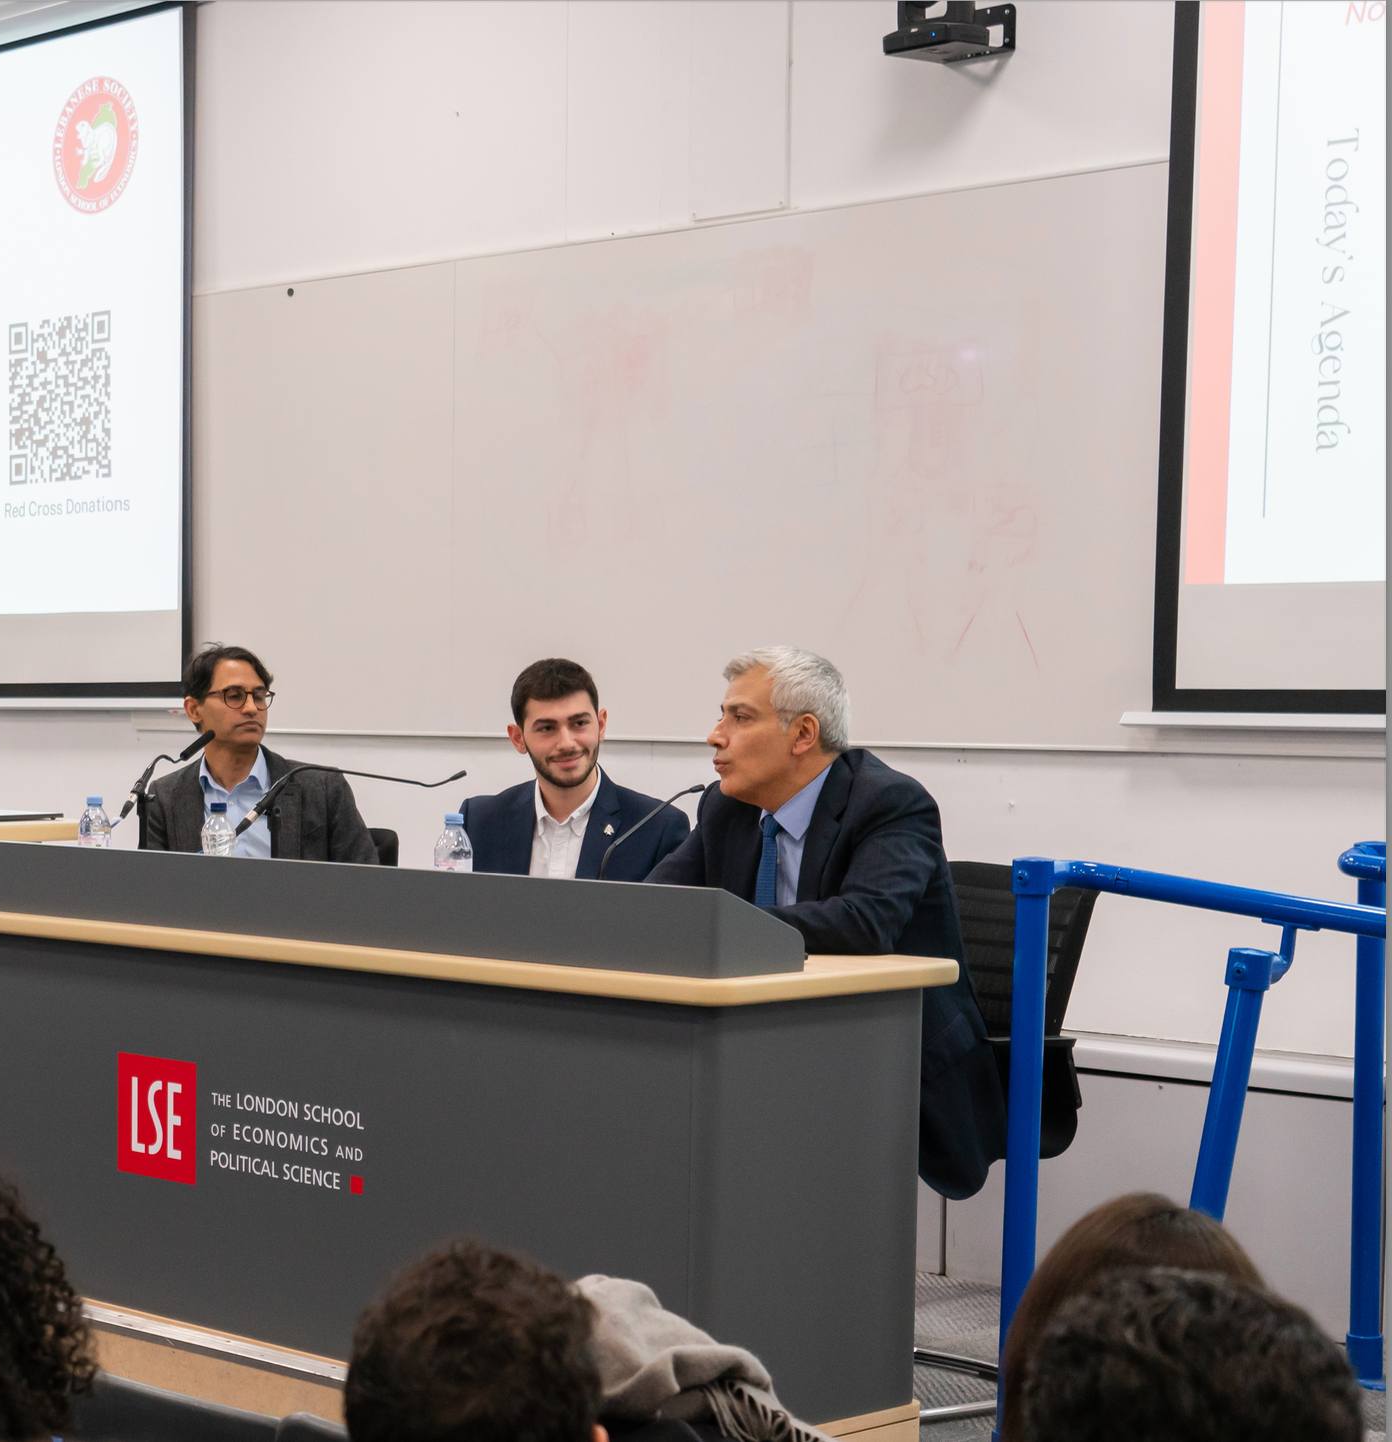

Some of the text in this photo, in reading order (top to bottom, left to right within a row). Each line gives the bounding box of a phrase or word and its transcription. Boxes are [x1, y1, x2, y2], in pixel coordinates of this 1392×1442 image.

[1310, 128, 1359, 454] Today's Agenda
[4, 496, 131, 518] Red Cross Donations
[130, 1076, 182, 1160] LSE
[211, 1092, 365, 1130] THE LONDON SCHOOL
[210, 1123, 363, 1162] OF ECONOMICS AND
[210, 1150, 341, 1190] POLITICAL SCIENCE
